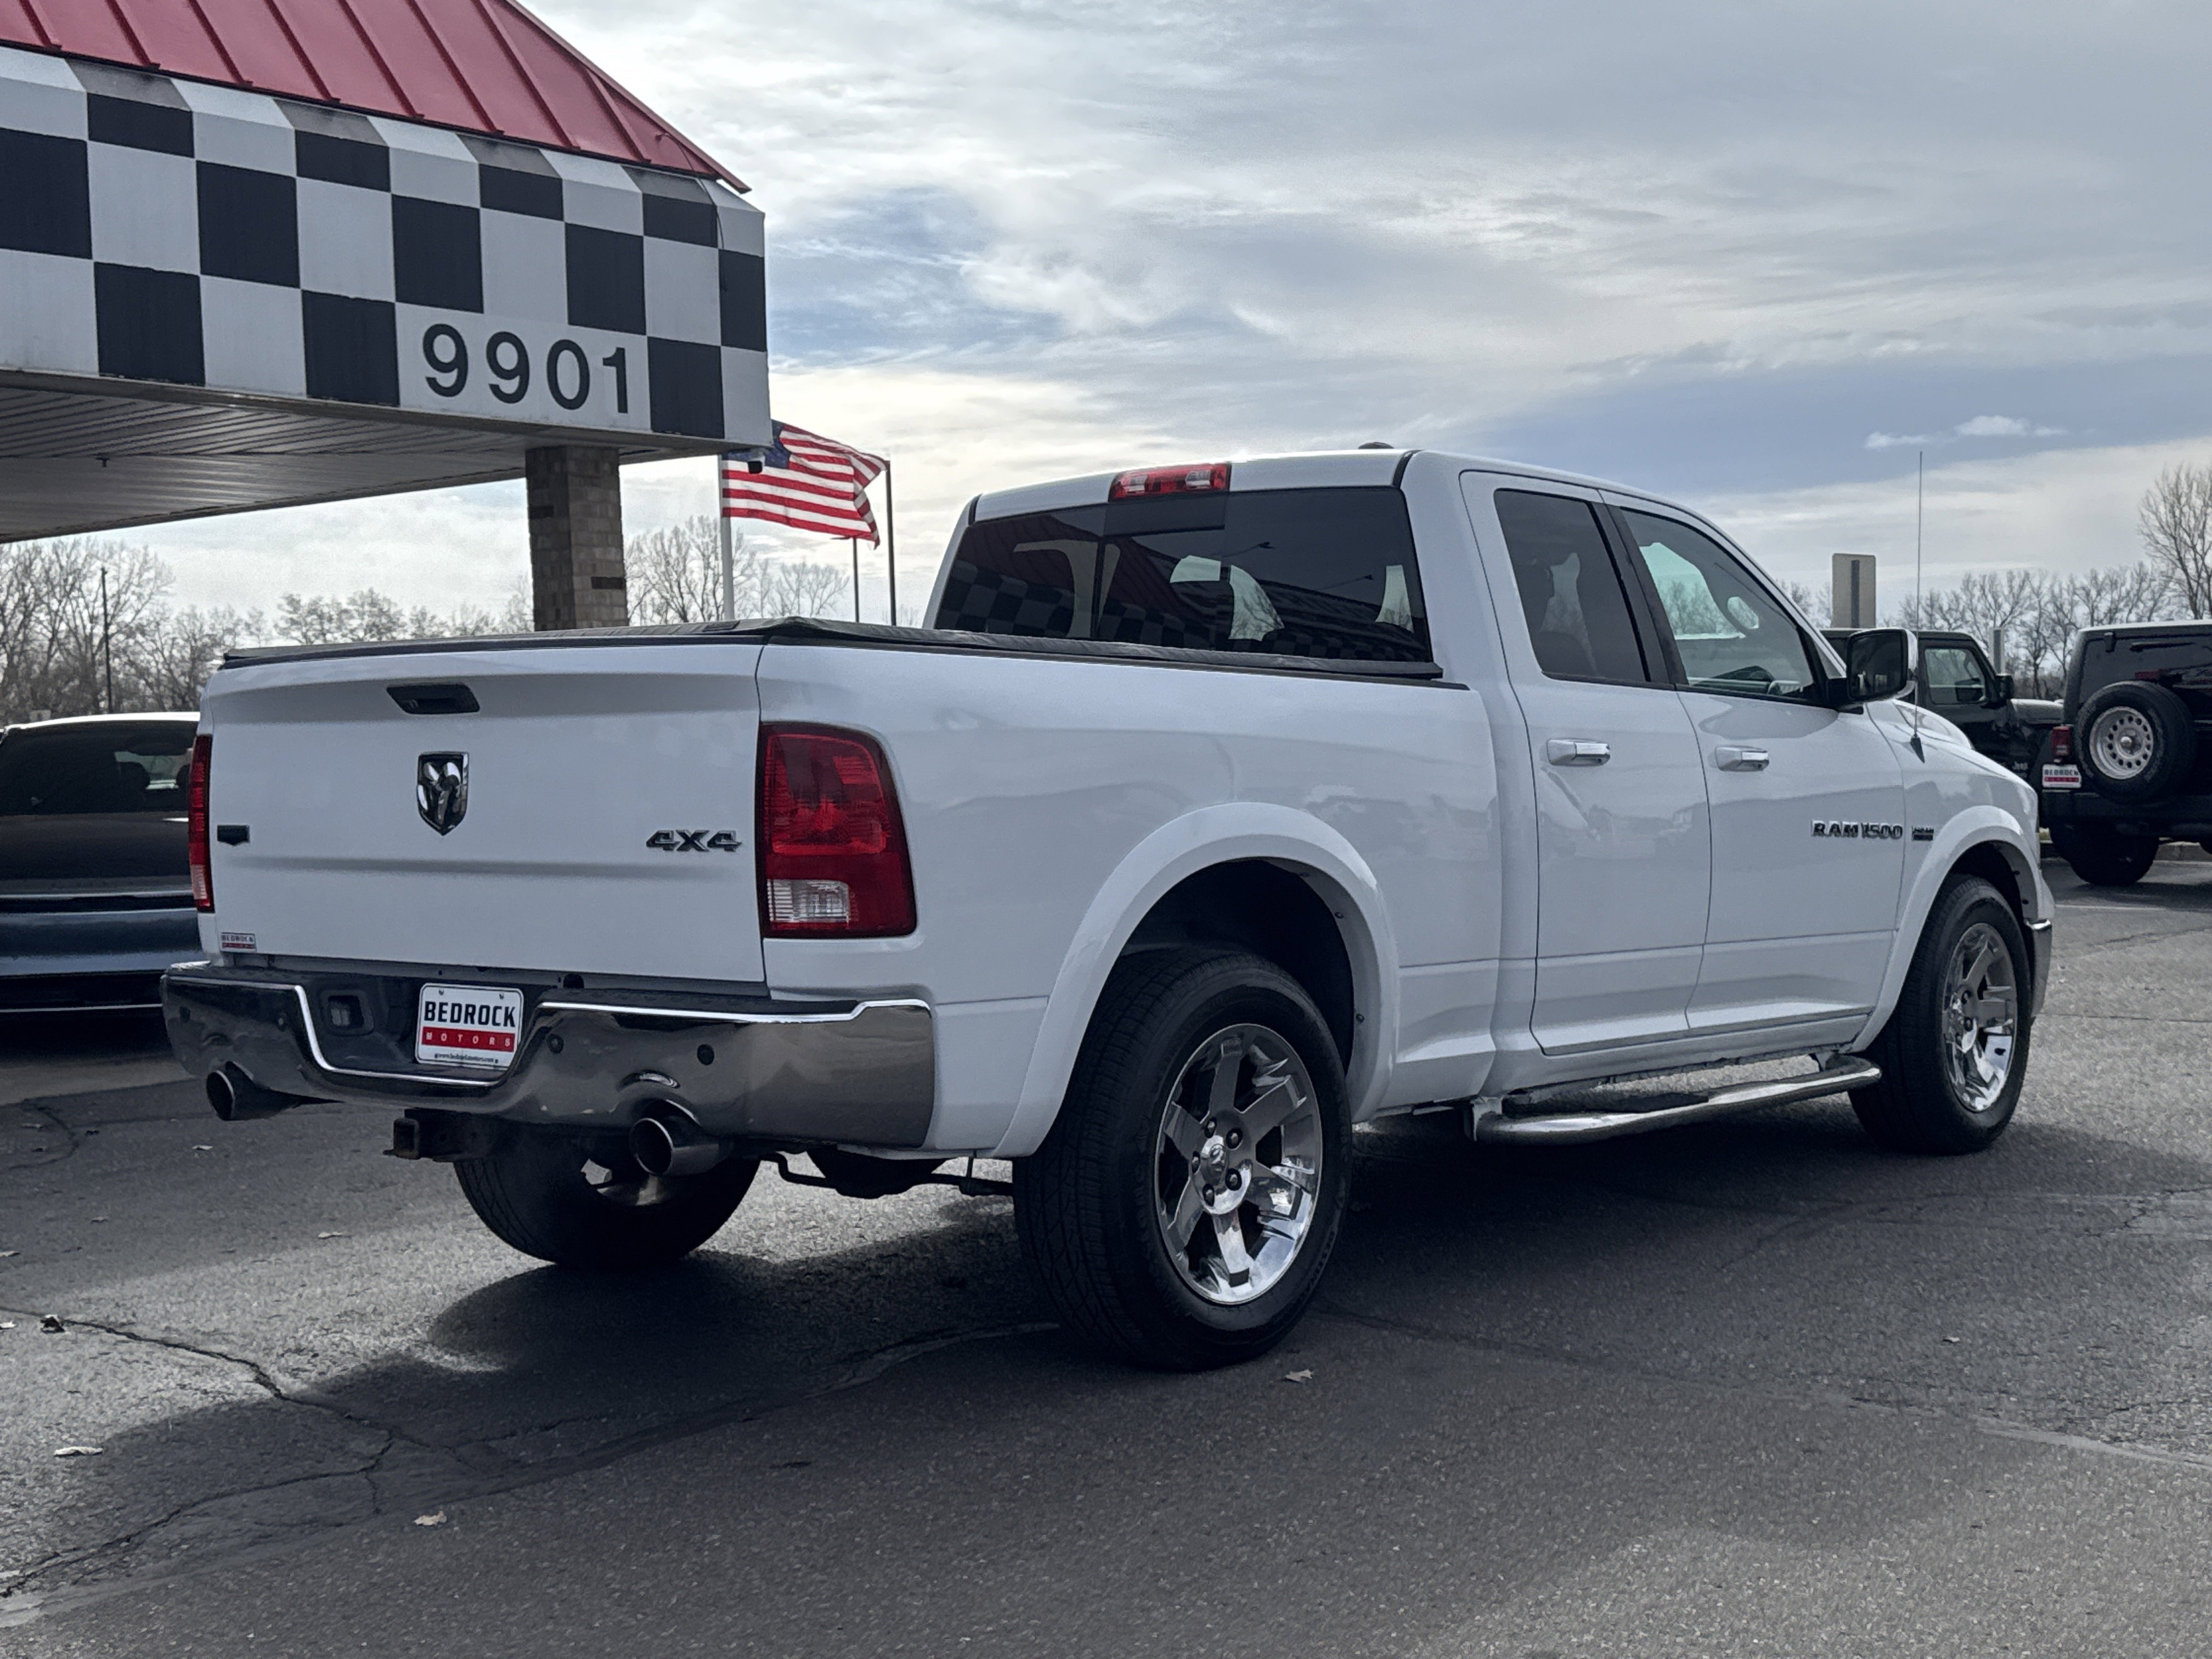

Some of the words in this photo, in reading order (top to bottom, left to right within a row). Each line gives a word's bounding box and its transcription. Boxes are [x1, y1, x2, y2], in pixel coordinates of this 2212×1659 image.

[422, 323, 629, 414] 9901
[1812, 820, 1859, 838] RAM
[1860, 822, 1903, 840] 1500
[424, 1001, 516, 1028] BEDROCK
[425, 1031, 511, 1047] MOTORS
